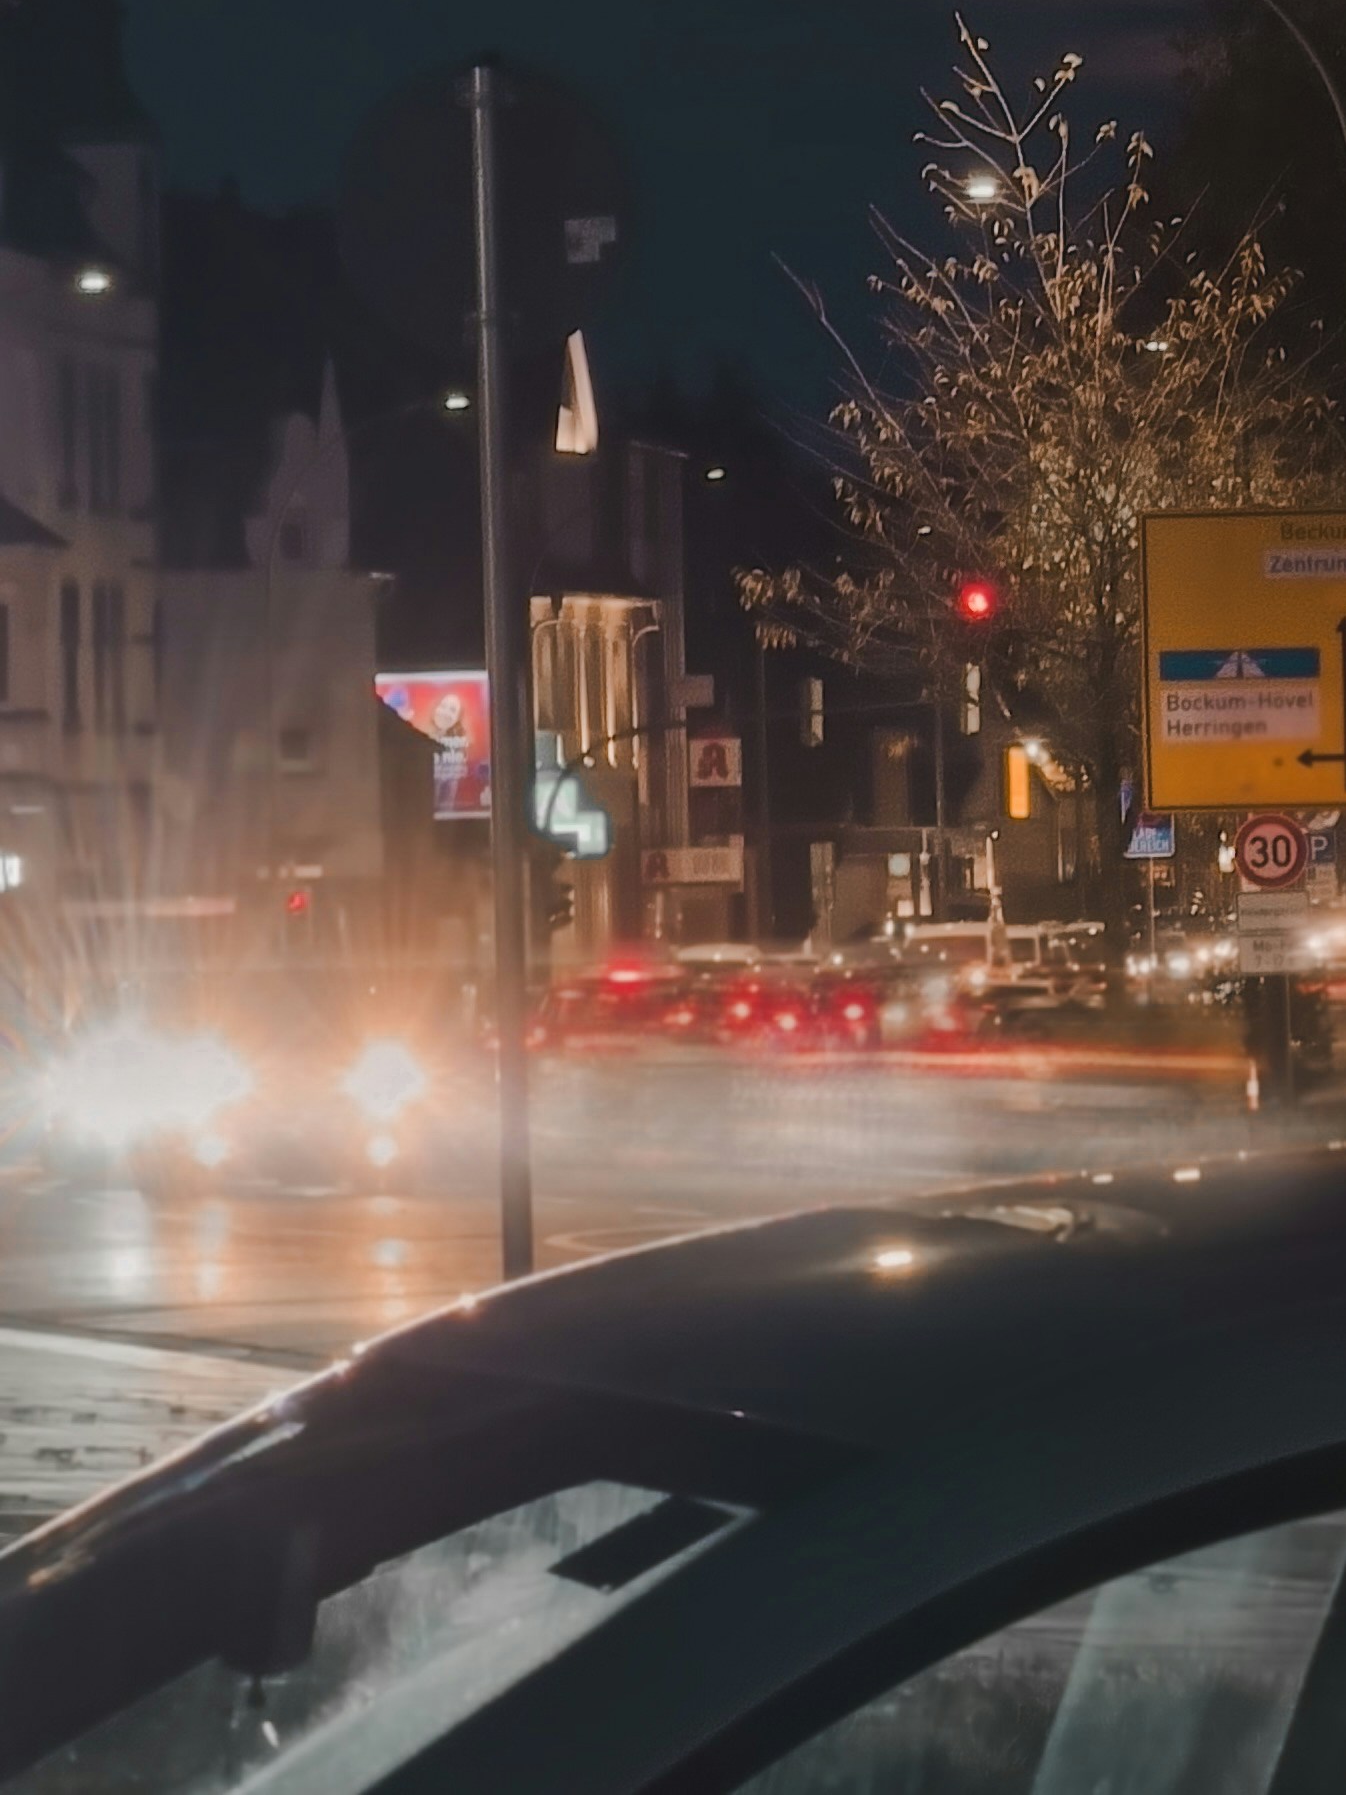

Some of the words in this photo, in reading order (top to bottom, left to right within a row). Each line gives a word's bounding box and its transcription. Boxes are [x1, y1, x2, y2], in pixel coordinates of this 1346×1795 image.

[1167, 719, 1267, 739] Herringen
[1249, 834, 1291, 868] 30
[1311, 836, 1328, 861] P
